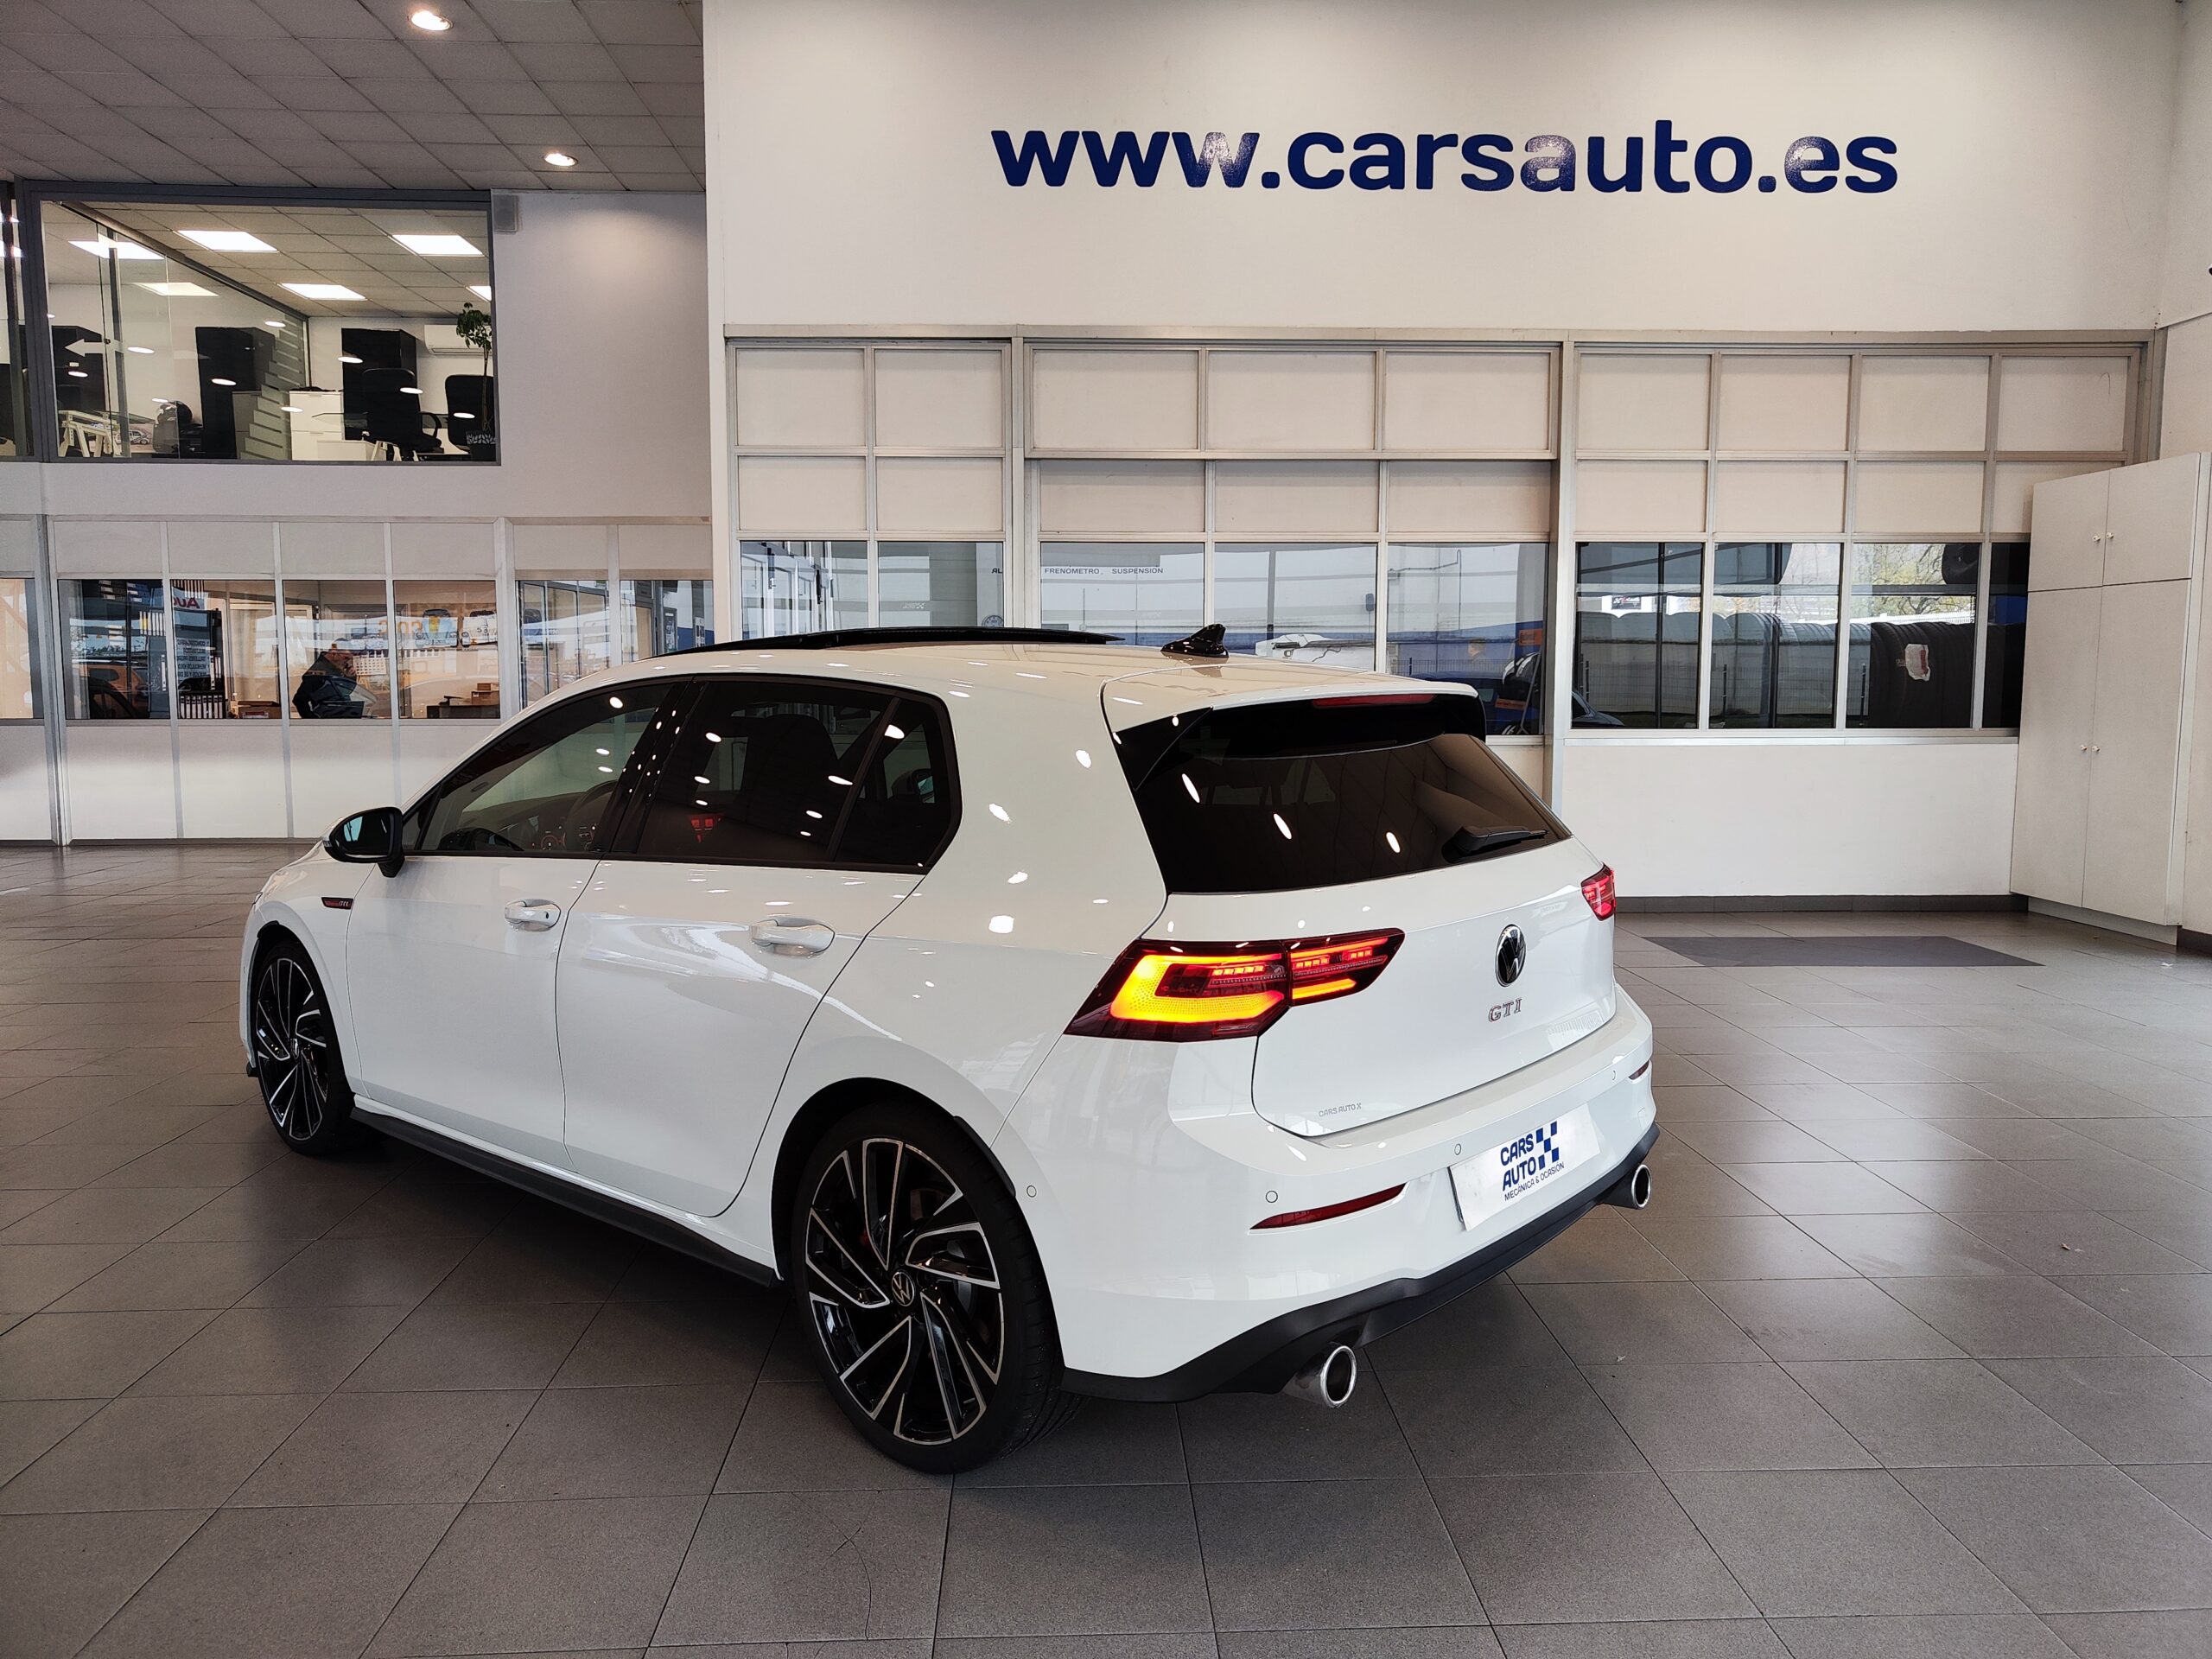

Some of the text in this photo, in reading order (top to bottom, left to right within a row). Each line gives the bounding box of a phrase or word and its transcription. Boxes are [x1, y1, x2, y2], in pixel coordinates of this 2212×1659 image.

[991, 119, 1897, 193] www.carsauto.es
[1488, 997, 1522, 1023] GTI
[1319, 1103, 1356, 1117] CARS AUTO
[1500, 1133, 1535, 1166] CARS
[1502, 1156, 1536, 1192] AUTO
